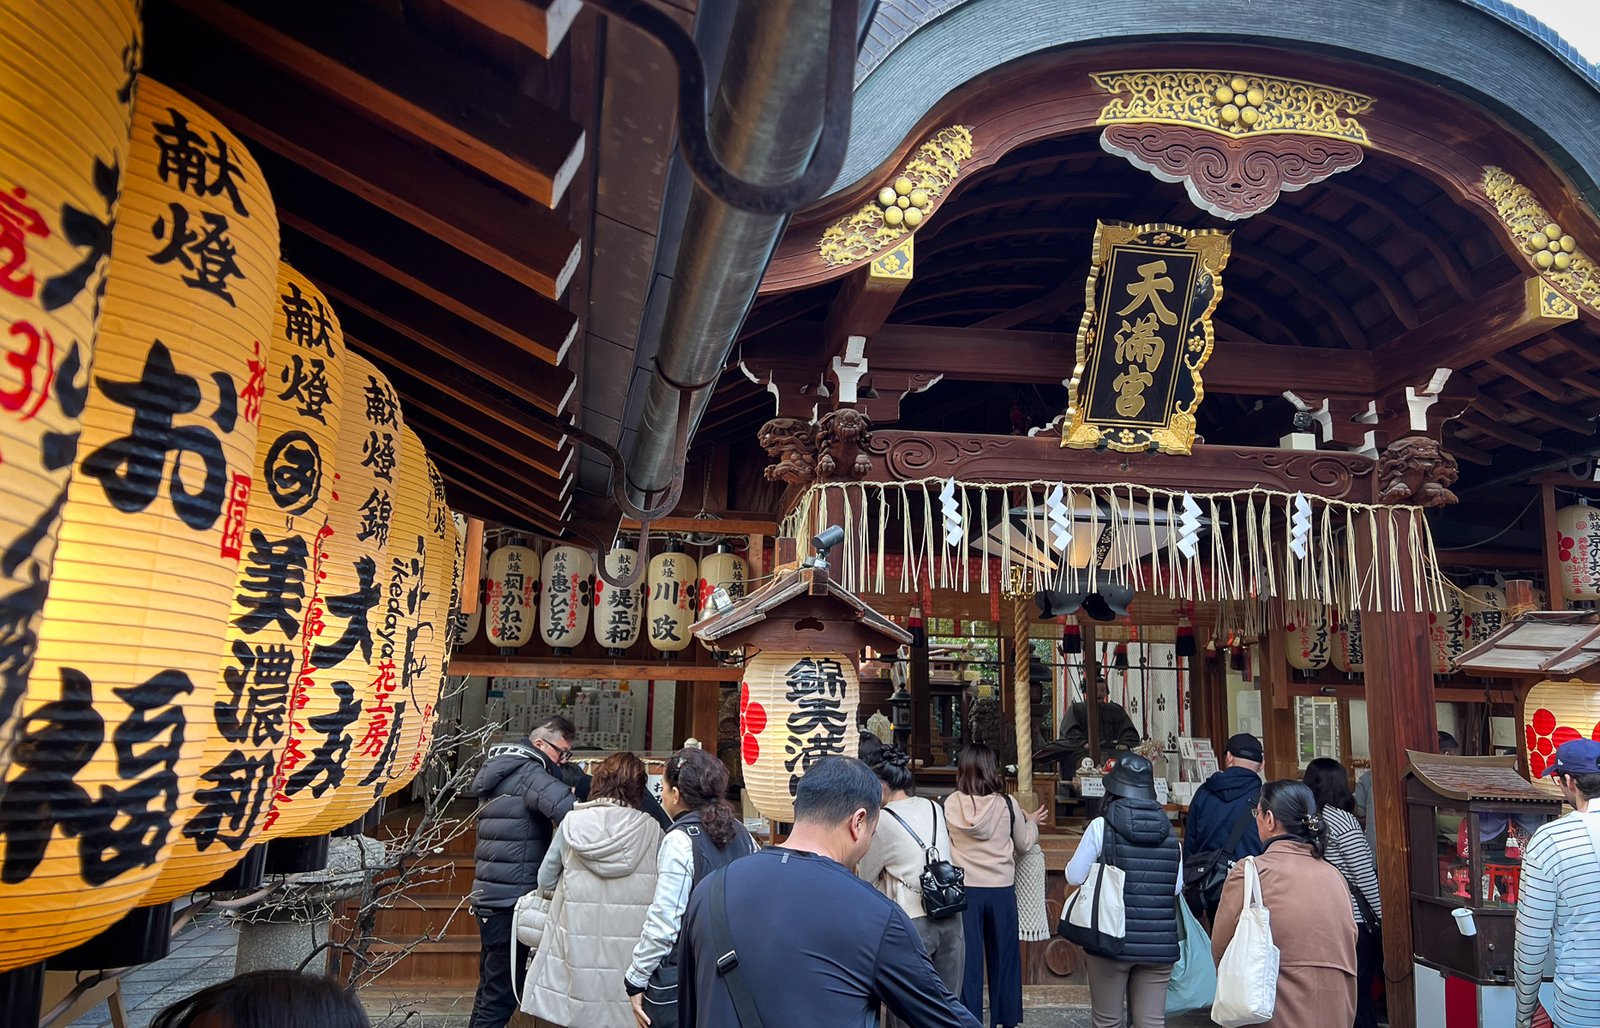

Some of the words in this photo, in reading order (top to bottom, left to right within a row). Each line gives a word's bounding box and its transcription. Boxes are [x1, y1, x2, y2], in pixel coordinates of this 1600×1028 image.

[147, 108, 250, 308] 献燈
[277, 282, 335, 427] 献燈
[1112, 259, 1178, 418] 天満宮
[360, 375, 399, 484] 献燈
[508, 552, 522, 572] 献燈
[553, 552, 568, 572] 献燈
[617, 554, 632, 574] 献燈
[661, 558, 675, 578] 献燈
[377, 558, 409, 659] ikedaya
[497, 590, 524, 641] かね松
[605, 588, 634, 643] 堤正和
[652, 581, 681, 641] 川政
[356, 658, 397, 758] 花工房
[784, 656, 849, 797] 錦天満
